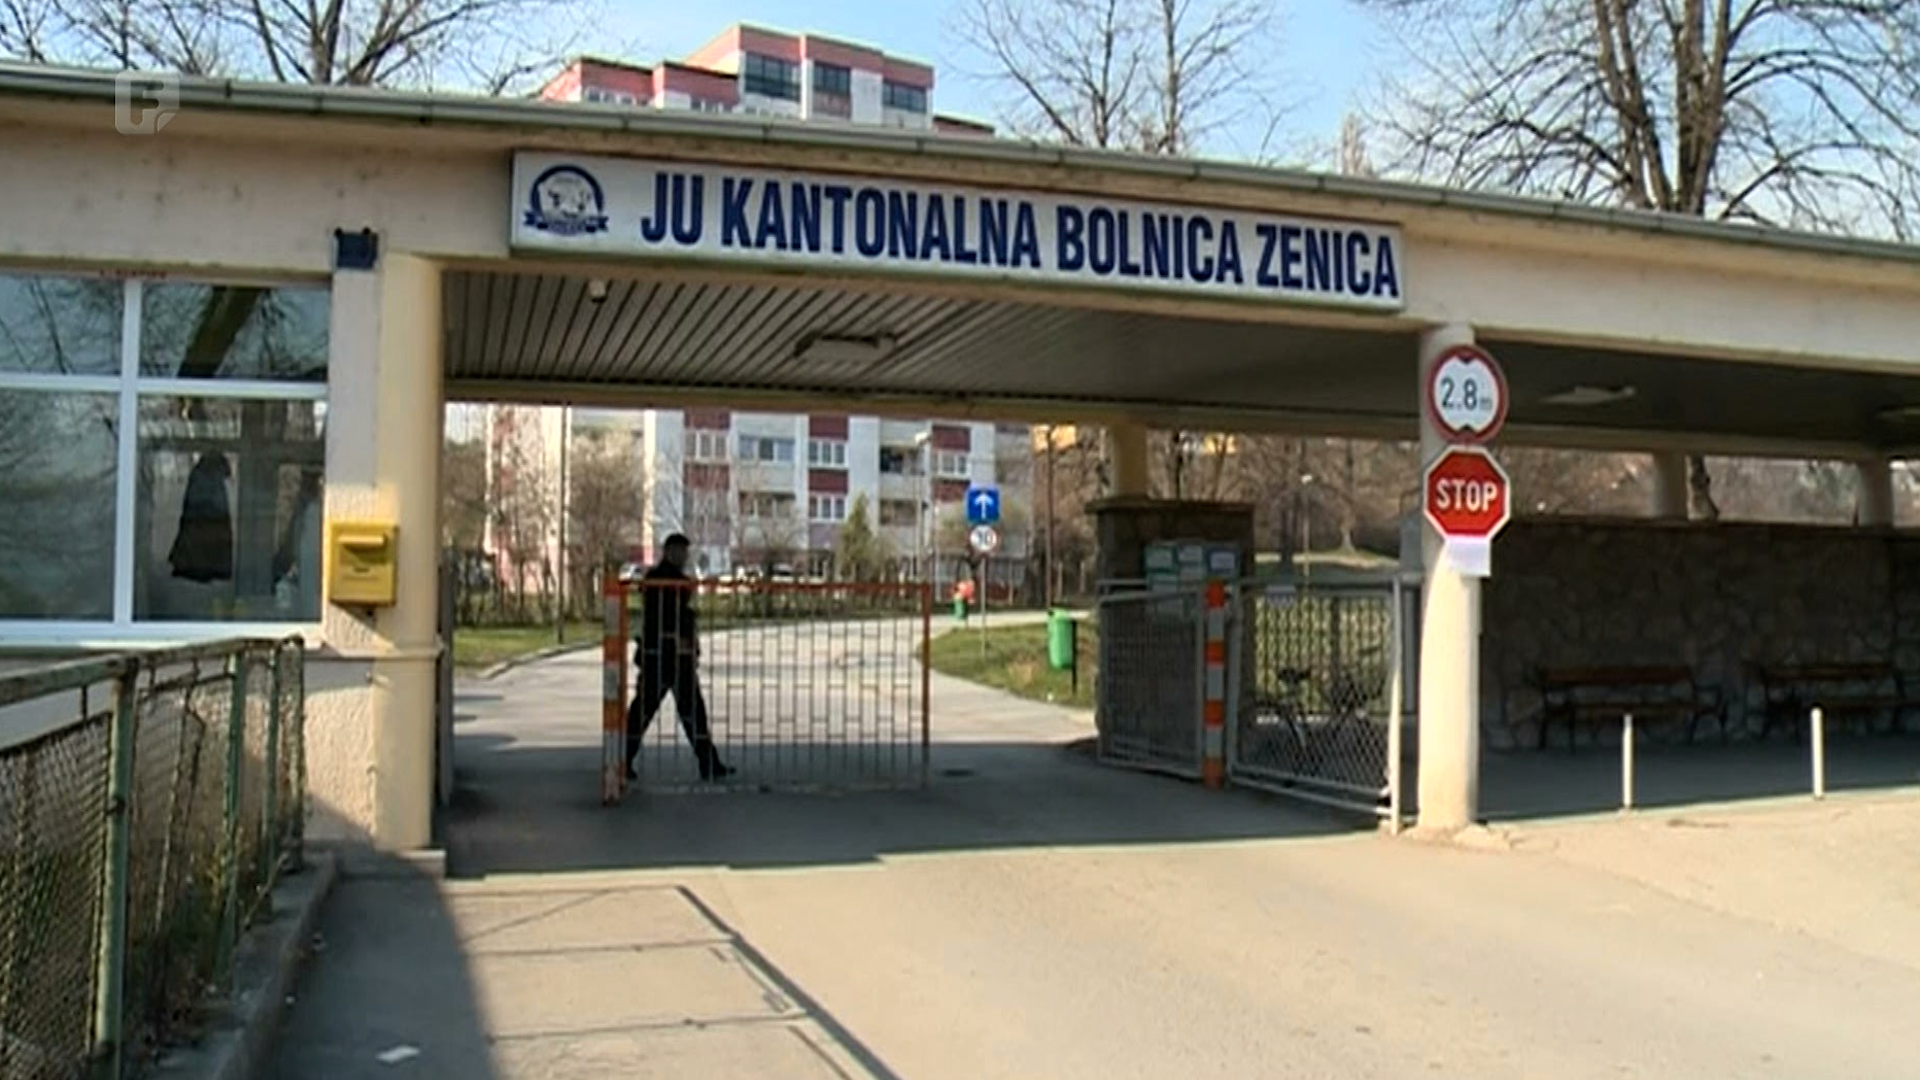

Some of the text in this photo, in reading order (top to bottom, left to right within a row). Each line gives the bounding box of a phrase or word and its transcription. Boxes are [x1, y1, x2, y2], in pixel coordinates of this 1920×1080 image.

[641, 172, 1399, 297] JU KANTONALNA BOLNICA ZENICA
[1437, 479, 1497, 511] STOP
